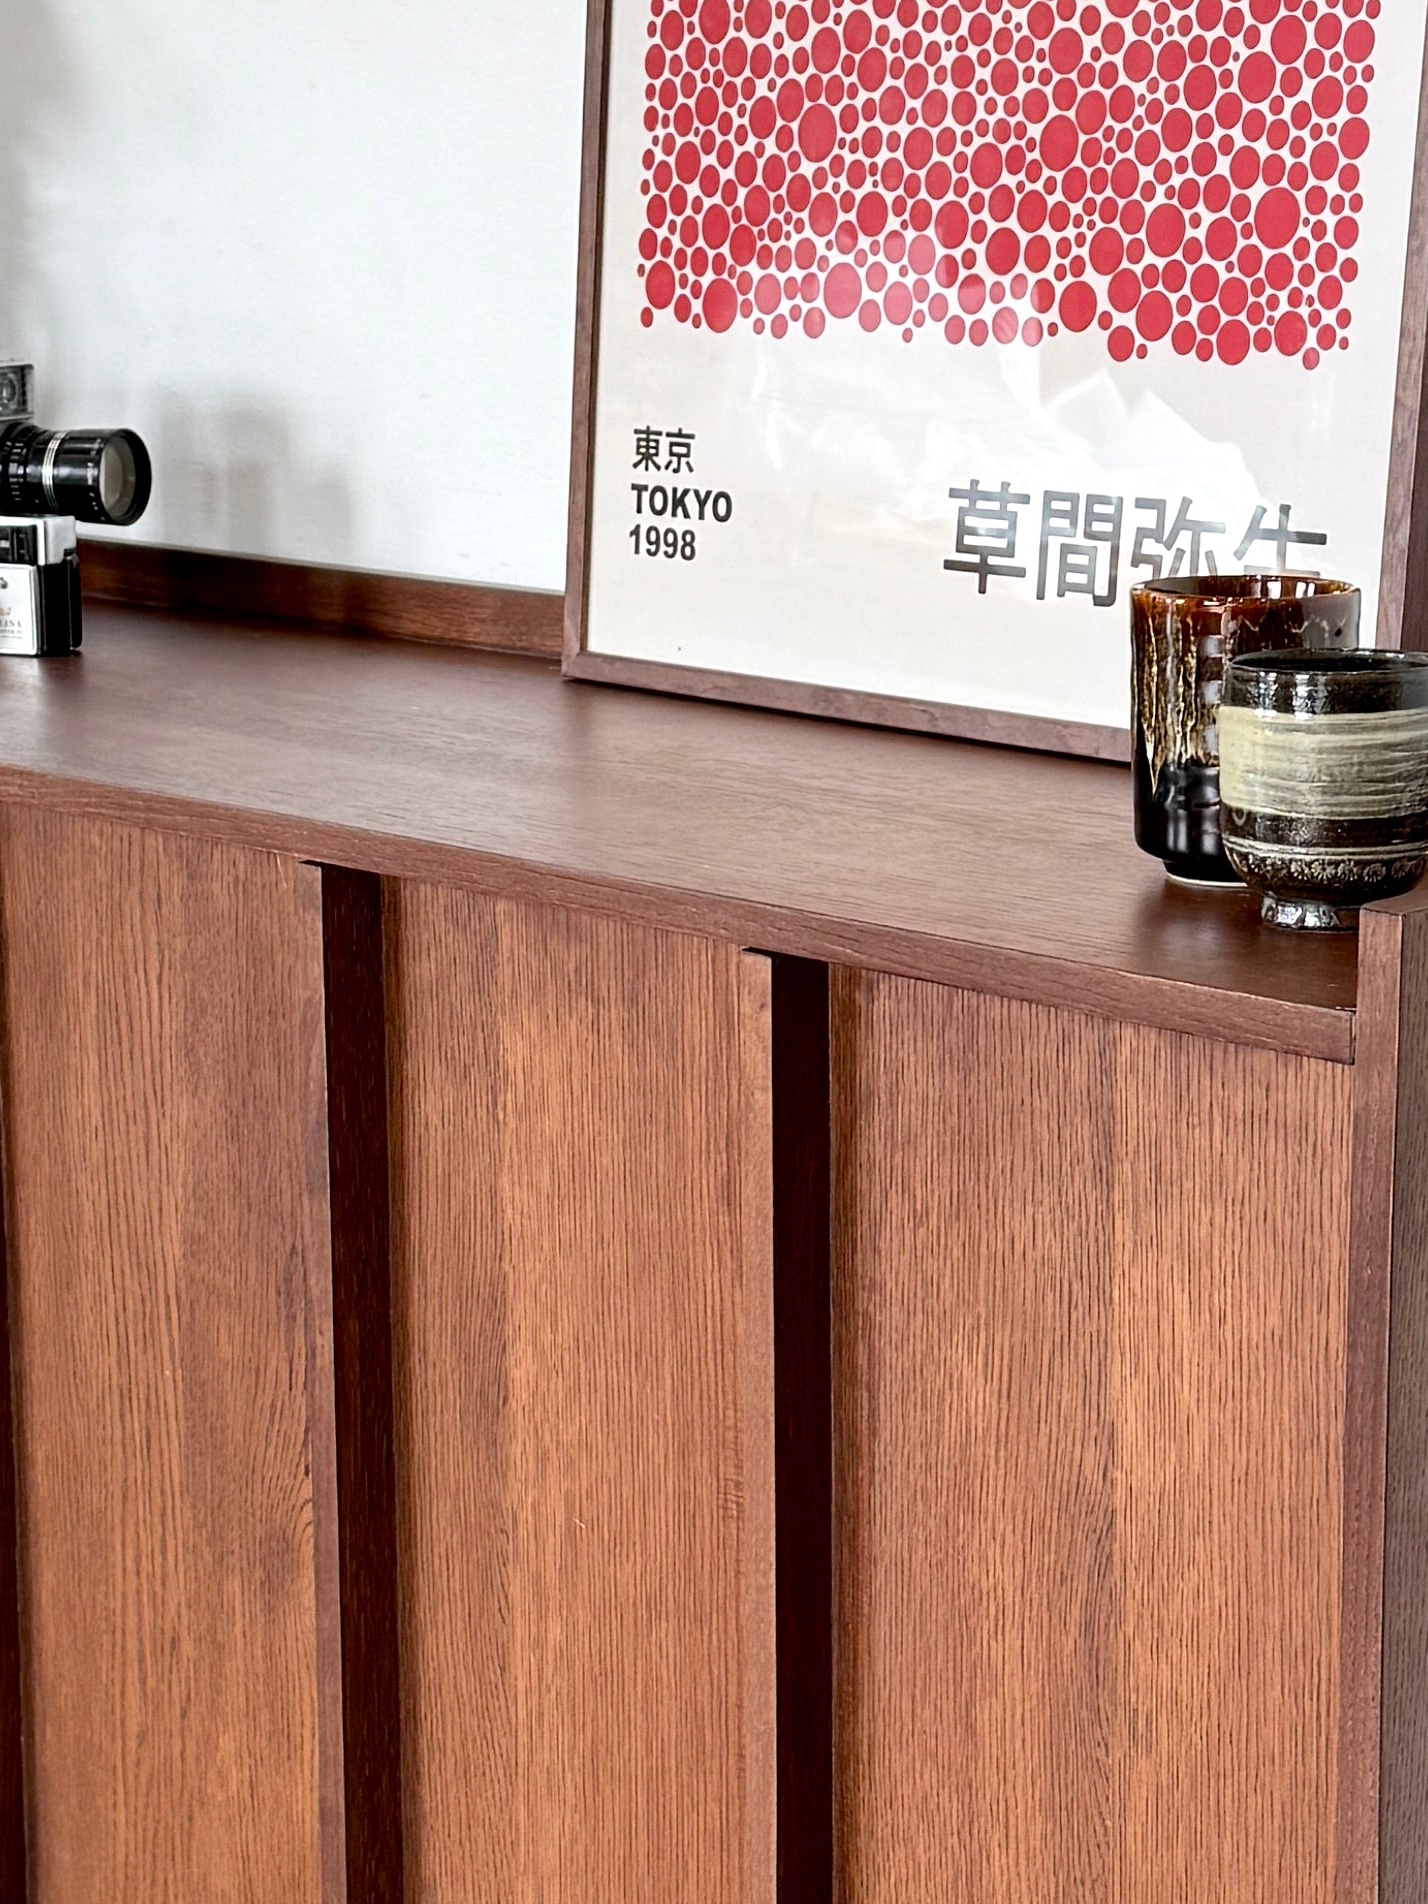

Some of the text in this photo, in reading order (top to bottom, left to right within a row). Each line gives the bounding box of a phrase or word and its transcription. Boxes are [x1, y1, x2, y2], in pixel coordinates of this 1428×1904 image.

[631, 425, 696, 474] 東京
[630, 483, 733, 523] TOKYO
[629, 523, 696, 561] 1998
[942, 478, 1328, 608] 草間弥生
